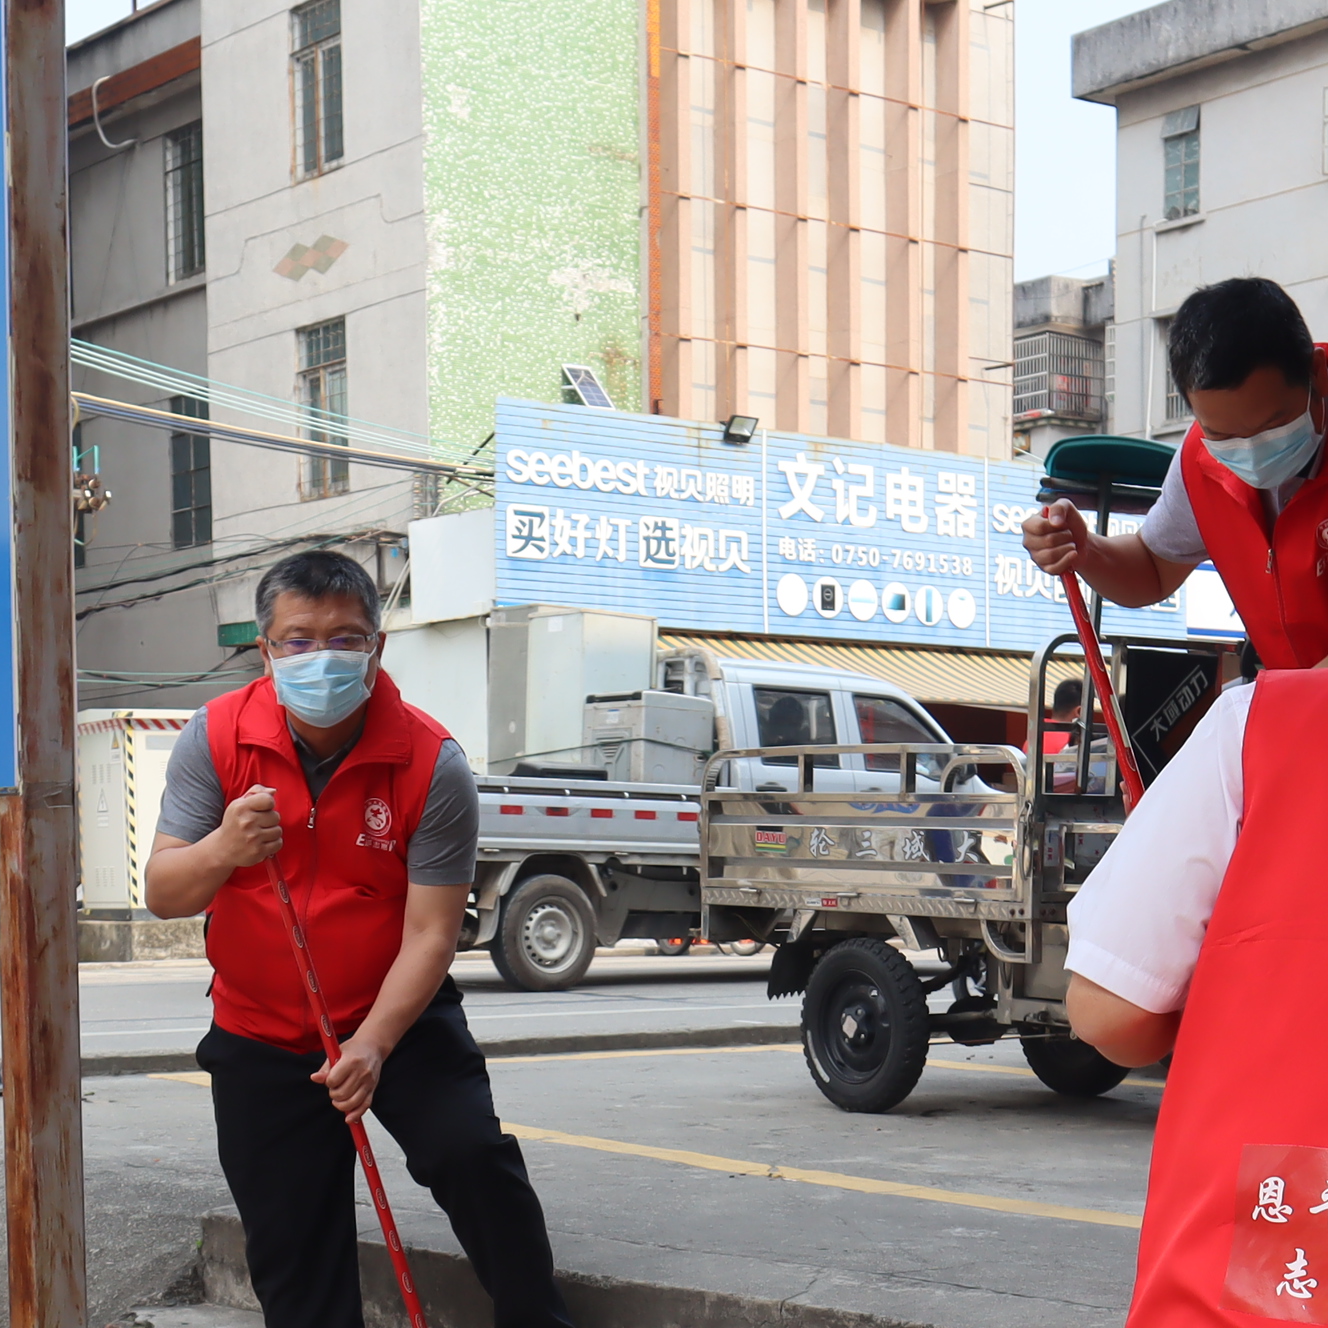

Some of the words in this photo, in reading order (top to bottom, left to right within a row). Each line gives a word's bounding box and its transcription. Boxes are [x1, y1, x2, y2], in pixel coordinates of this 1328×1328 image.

[506, 448, 650, 497] seebest
[653, 464, 755, 507] 视贝照明
[777, 452, 978, 538] 文记电器
[506, 503, 752, 575] 买好灯选视贝
[831, 543, 974, 576] 0750-7691538
[755, 831, 787, 844] DAYU
